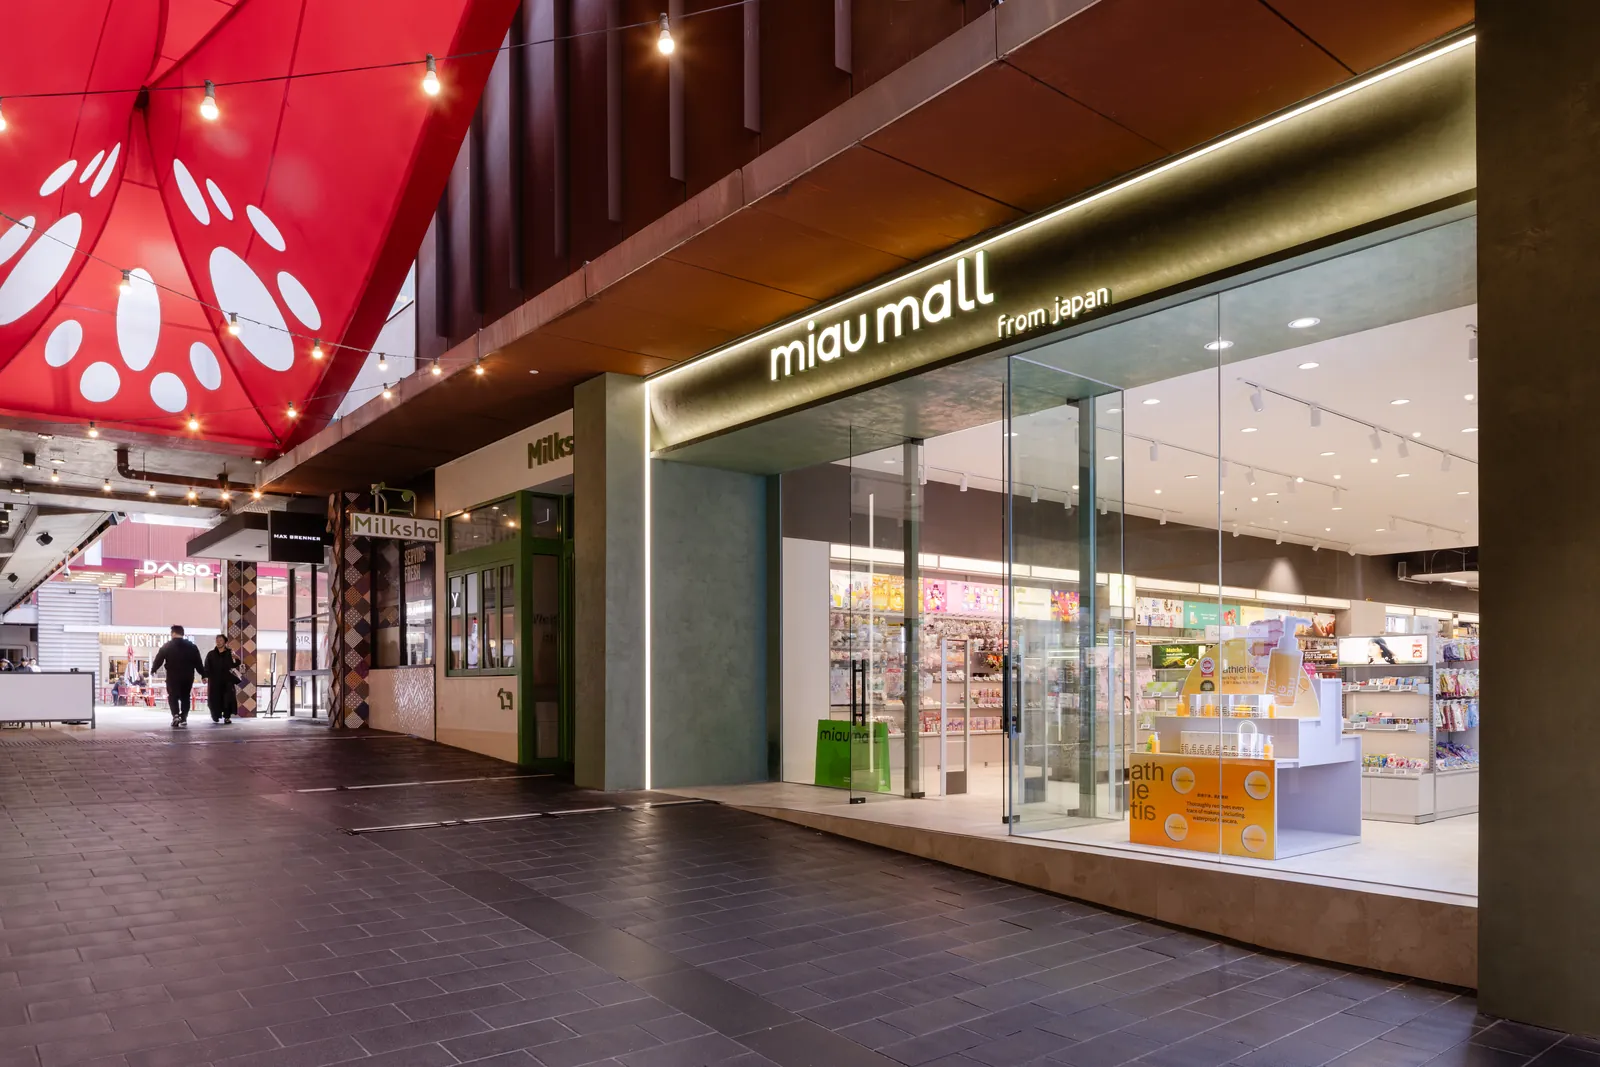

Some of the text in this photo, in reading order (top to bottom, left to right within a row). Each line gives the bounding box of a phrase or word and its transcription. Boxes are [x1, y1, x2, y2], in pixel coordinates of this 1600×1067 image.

[770, 250, 995, 382] miau mall
[998, 288, 1109, 339] from japan
[355, 515, 439, 539] Milksha
[289, 534, 321, 542] BRENNER
[404, 545, 427, 566] SERVING
[143, 560, 211, 577] DAISO
[404, 563, 421, 582] FRESH
[124, 634, 156, 648] SUSHI
[820, 727, 878, 744] miau mal
[1131, 762, 1164, 781] ath
[1132, 781, 1149, 800] le
